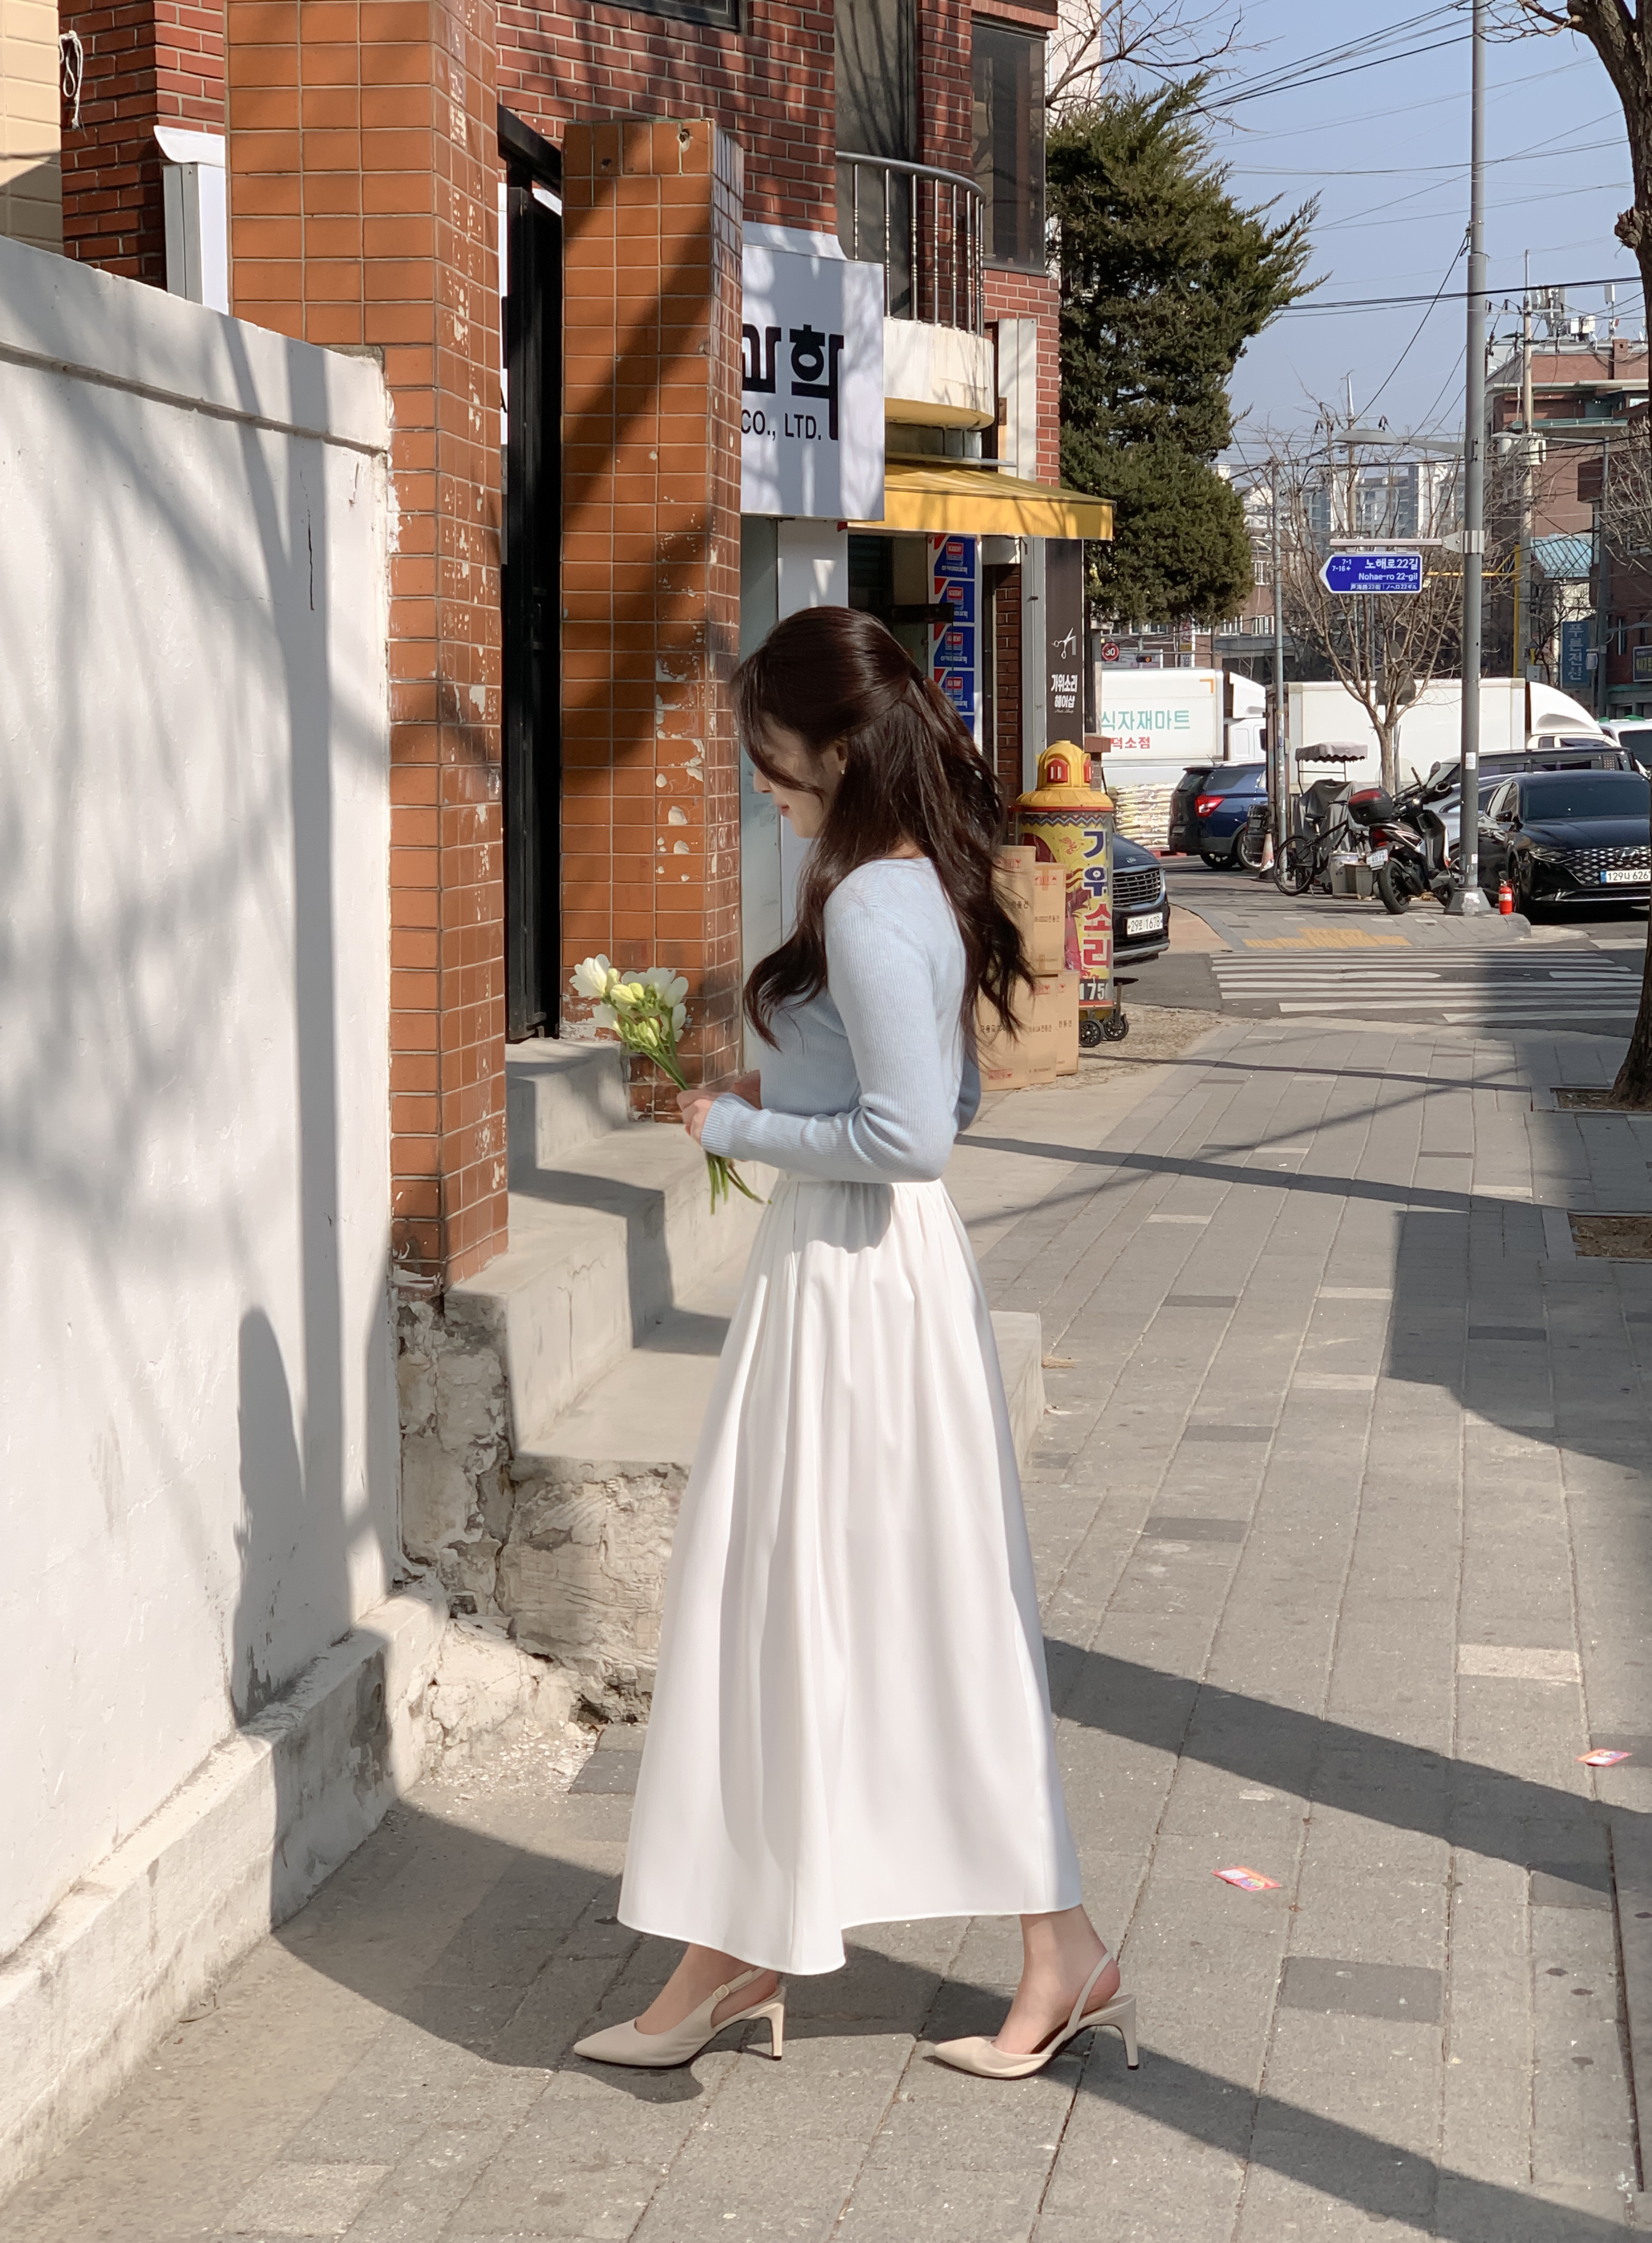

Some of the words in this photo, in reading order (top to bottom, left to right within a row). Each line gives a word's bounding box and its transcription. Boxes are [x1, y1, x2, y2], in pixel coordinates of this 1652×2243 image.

[785, 413, 821, 440] LTD.
[1365, 558, 1418, 570] 노해로22길
[1396, 572, 1418, 581] 22-gil
[1051, 674, 1078, 693] 가위소리
[1101, 710, 1190, 731] 식자재마트
[1632, 871, 1651, 880] 626
